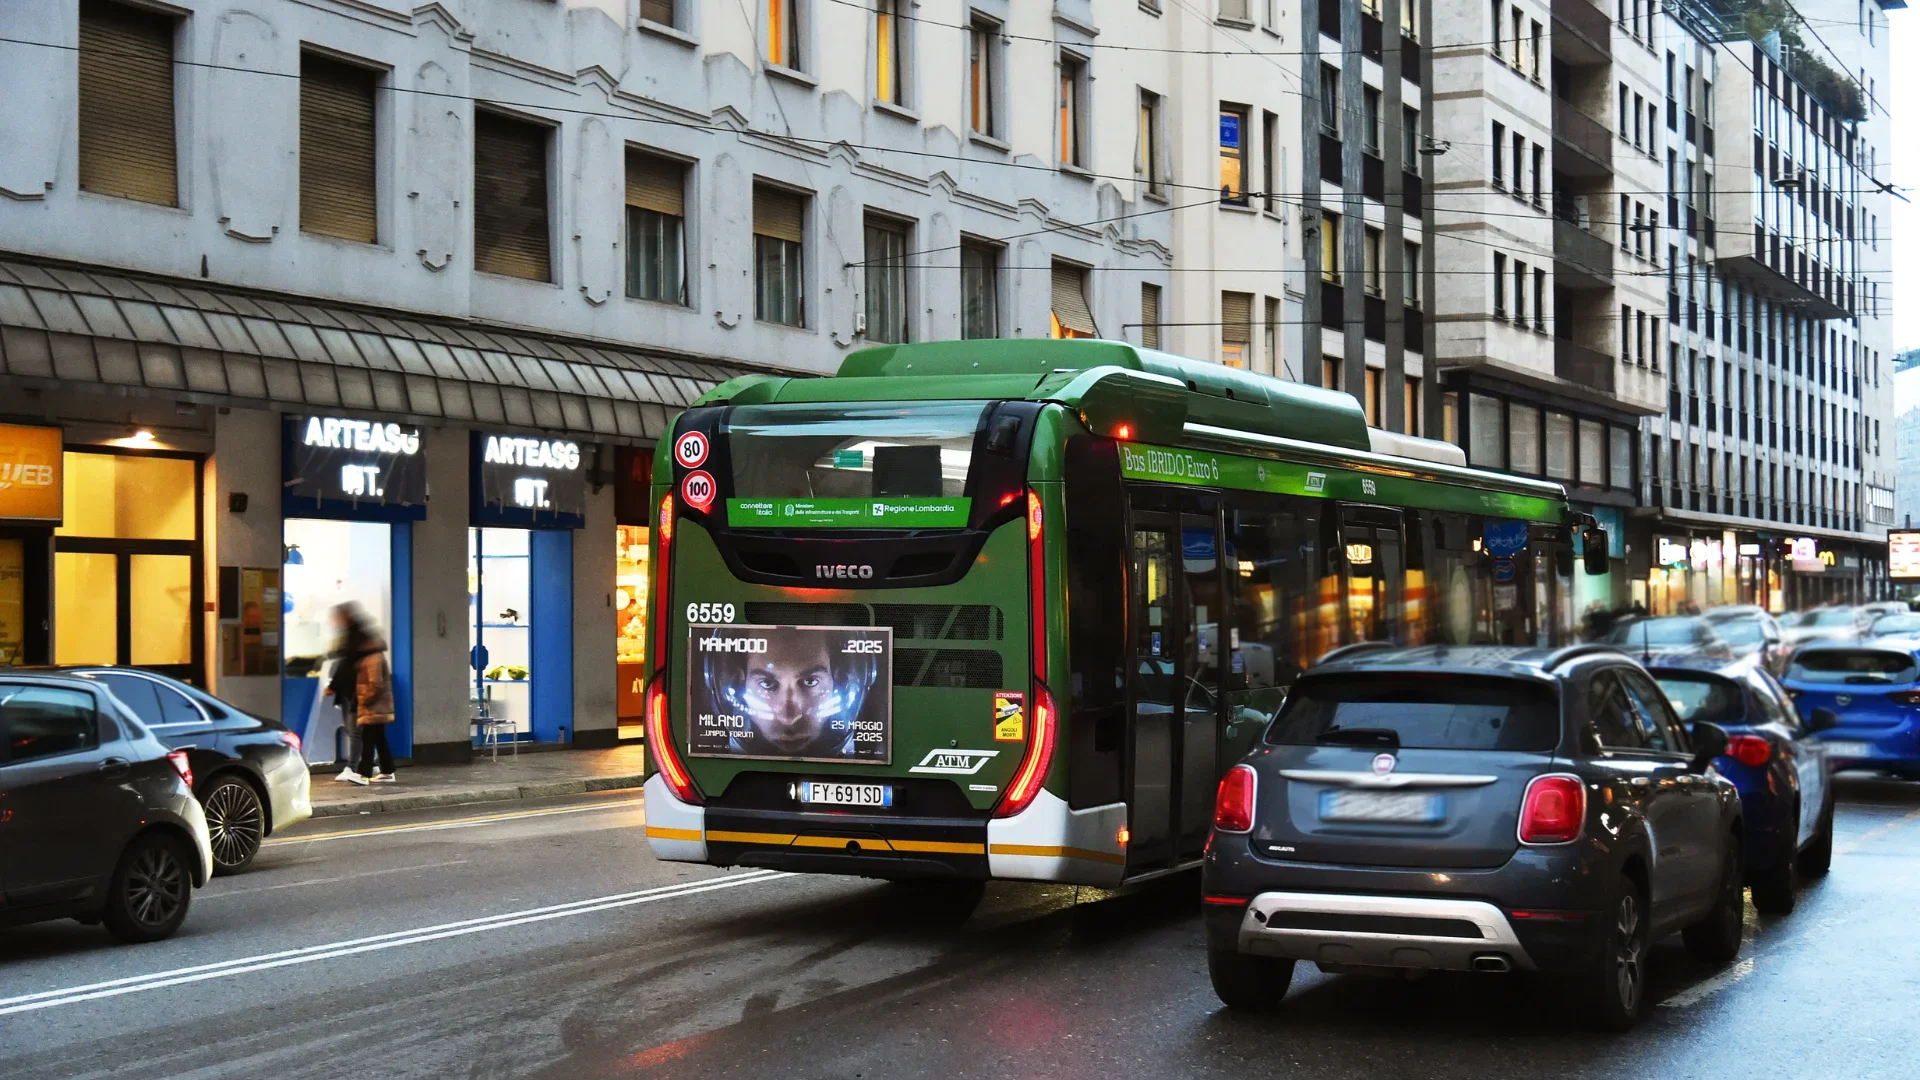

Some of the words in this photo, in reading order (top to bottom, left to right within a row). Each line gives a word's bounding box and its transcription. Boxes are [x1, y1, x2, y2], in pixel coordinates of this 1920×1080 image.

[304, 416, 419, 454] ARTEASG
[484, 435, 580, 470] ARTEASG
[684, 440, 700, 458] 80
[1123, 447, 1146, 472] Bus
[1147, 450, 1185, 477] IBRIDO
[1185, 455, 1210, 479] Euro
[1211, 458, 1219, 480] 6
[689, 481, 708, 496] 100
[884, 504, 914, 513] Regione
[915, 504, 955, 512] Lombardia
[815, 565, 874, 579] IVECO
[687, 603, 735, 623] 6559
[700, 637, 767, 654] MAHMOOD
[699, 714, 744, 728] MILANO
[831, 720, 845, 730] 25
[848, 721, 883, 731] MAGGIO
[729, 731, 754, 739] FORUM
[935, 755, 971, 768] ATM
